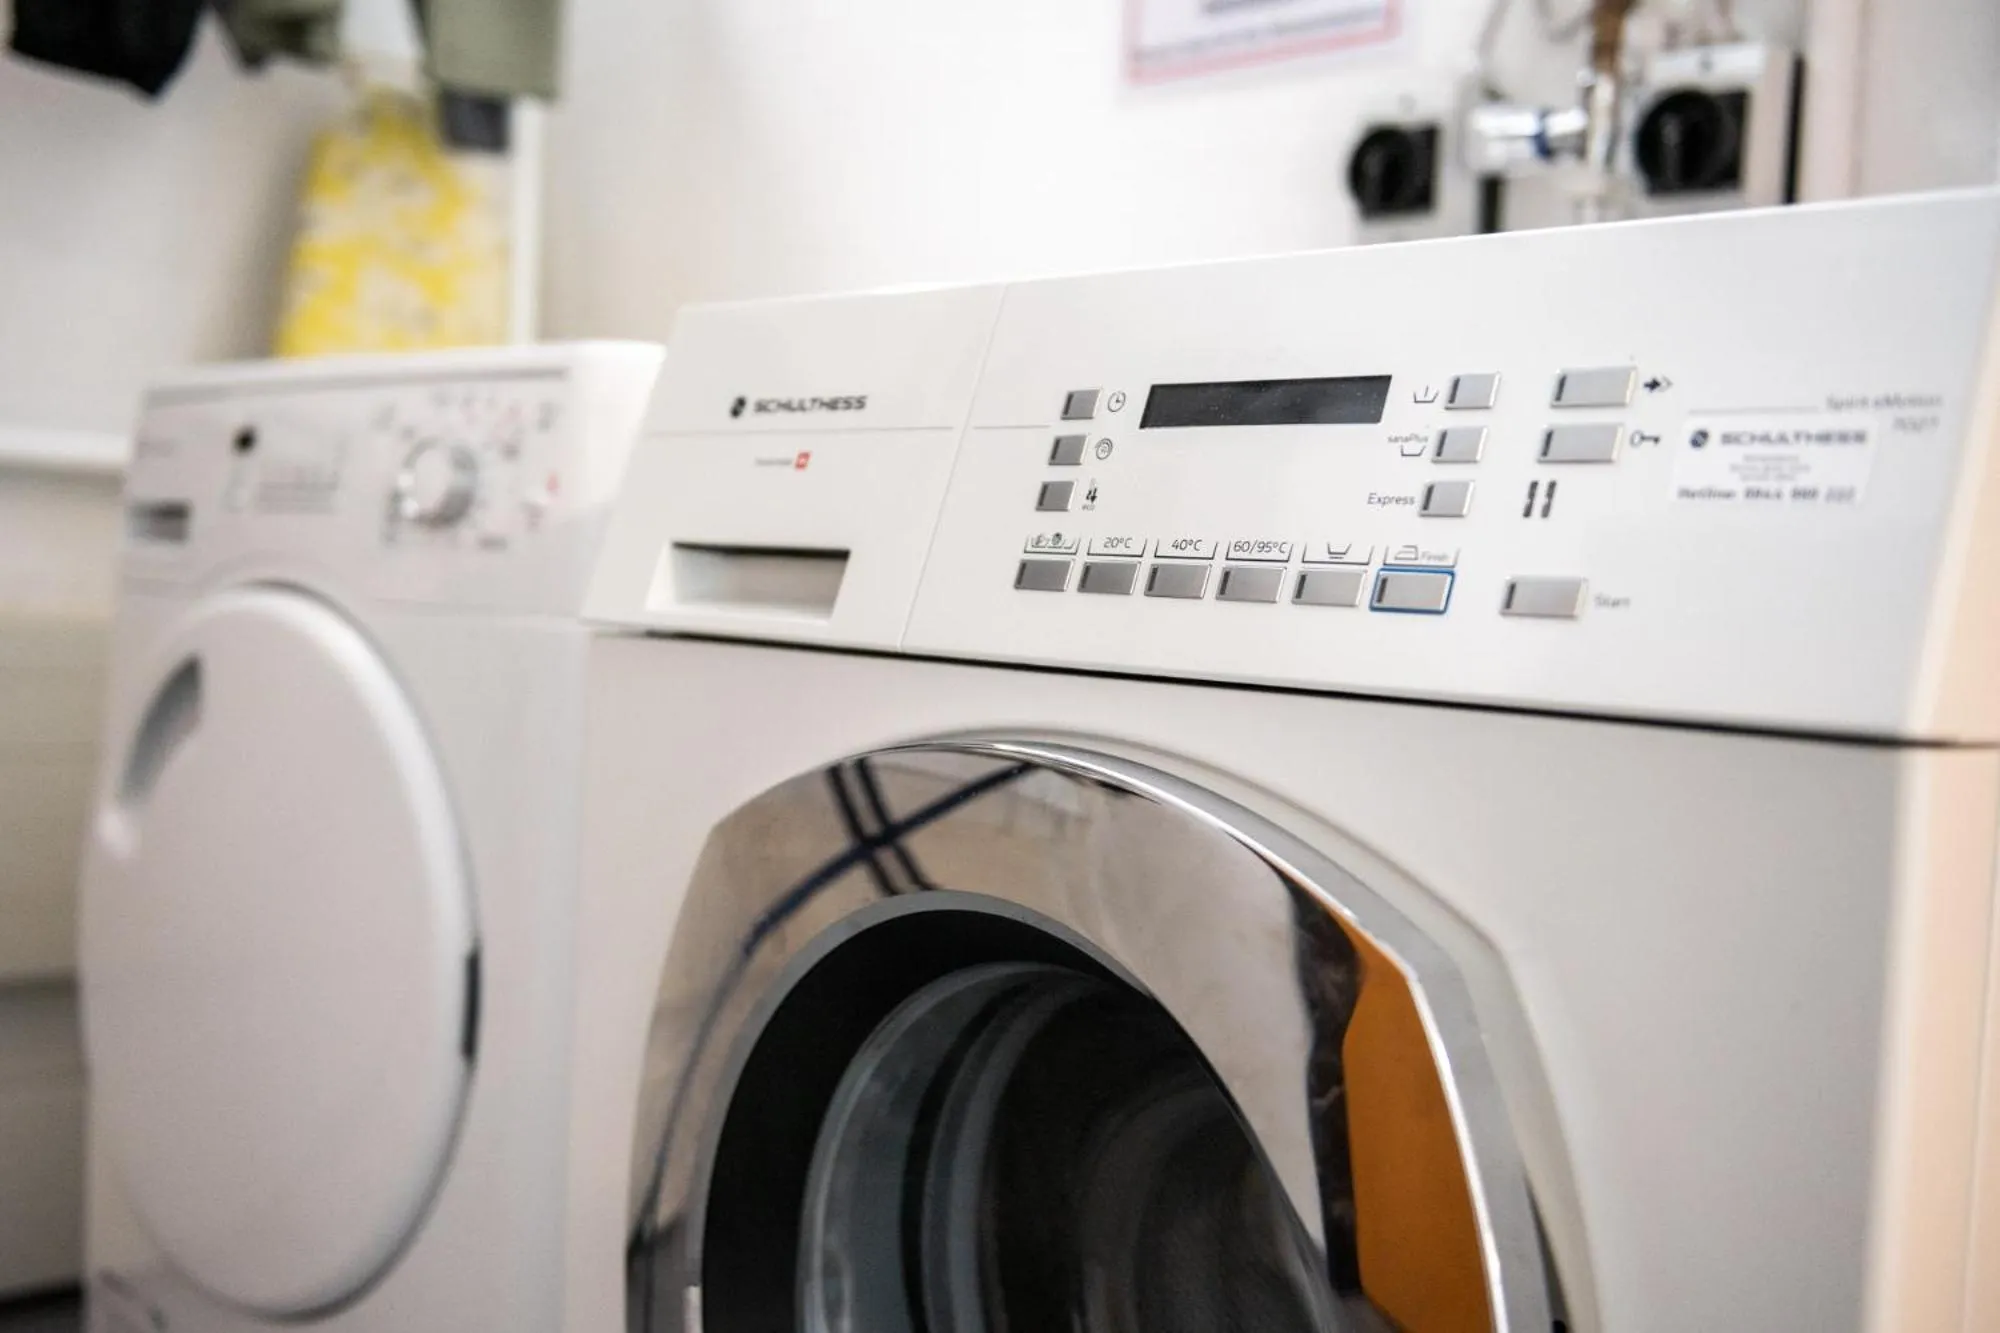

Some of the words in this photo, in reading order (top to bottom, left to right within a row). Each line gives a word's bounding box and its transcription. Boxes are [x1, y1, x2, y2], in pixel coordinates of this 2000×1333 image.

[754, 395, 867, 414] SCHULTHESS
[1720, 429, 1867, 446] SCHULTHESS
[1367, 492, 1416, 508] Express
[1103, 536, 1133, 550] 20°C
[1171, 538, 1202, 552] 40°C
[1233, 540, 1288, 555] 60/95°C
[1594, 592, 1631, 609] Start
